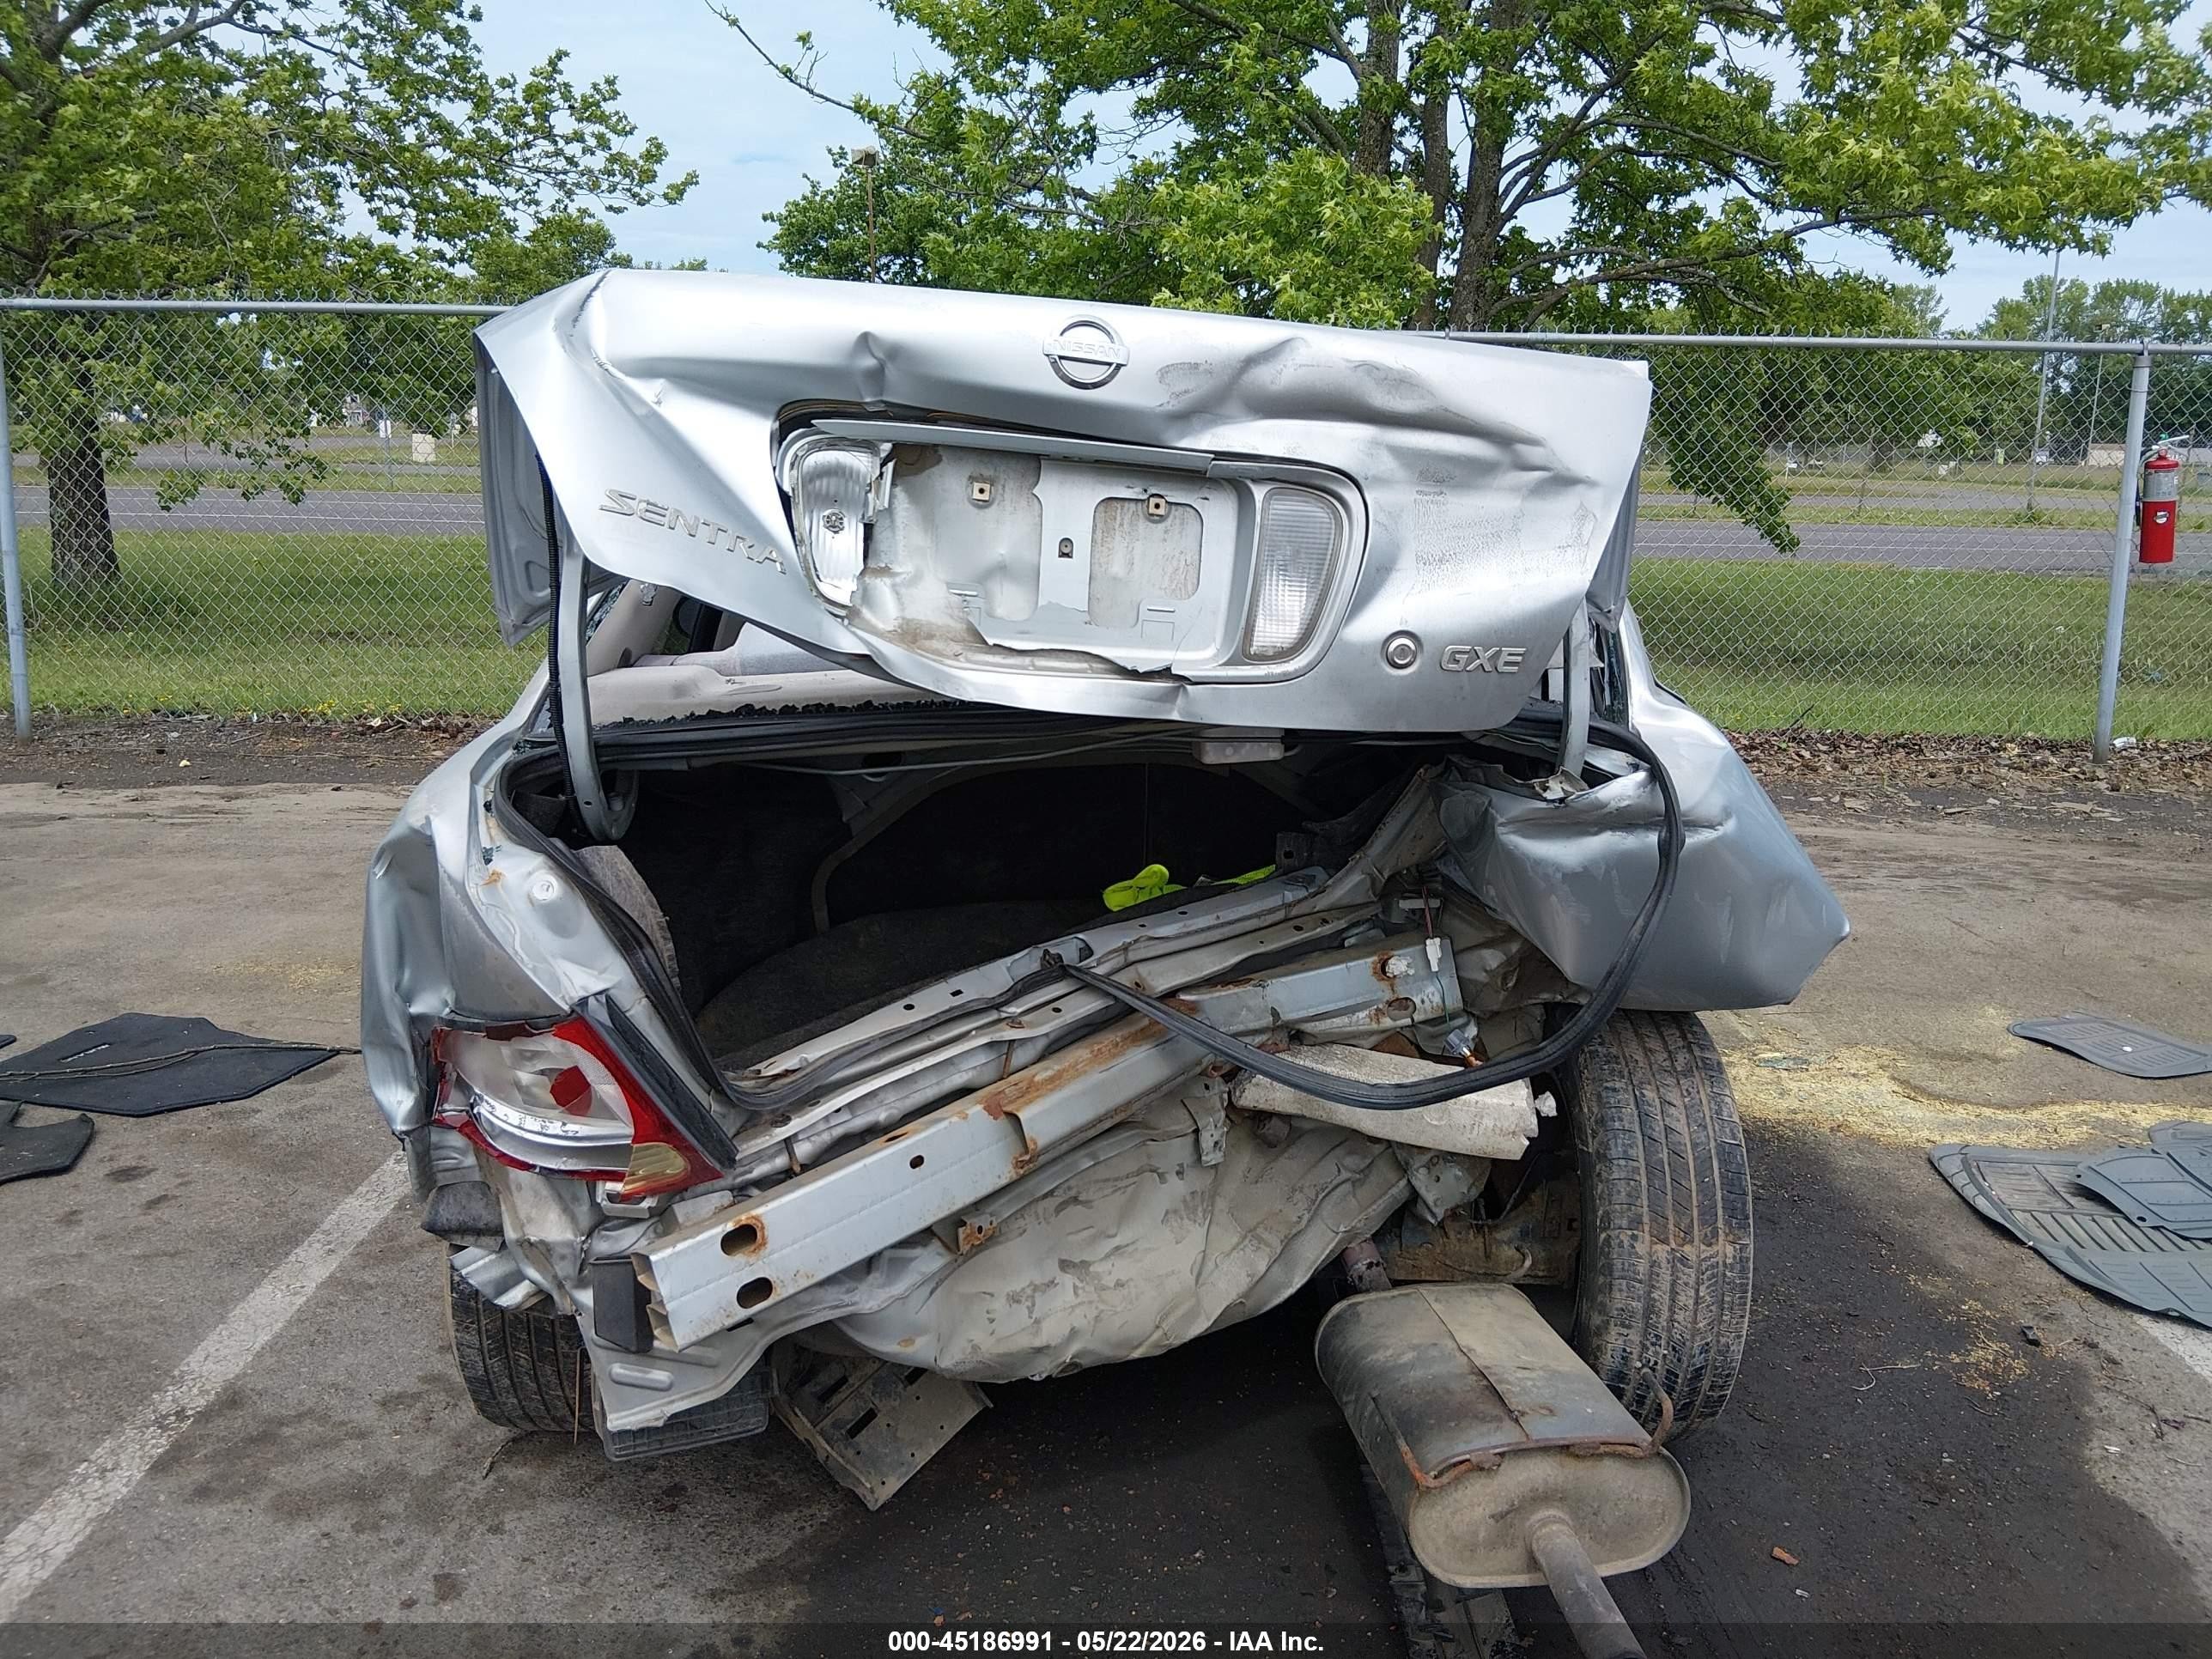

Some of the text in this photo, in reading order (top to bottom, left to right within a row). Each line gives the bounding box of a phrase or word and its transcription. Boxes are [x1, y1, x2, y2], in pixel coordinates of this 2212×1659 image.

[1053, 339, 1121, 360] NISSAN
[599, 488, 787, 574] SENTRA
[1439, 645, 1527, 673] GXE
